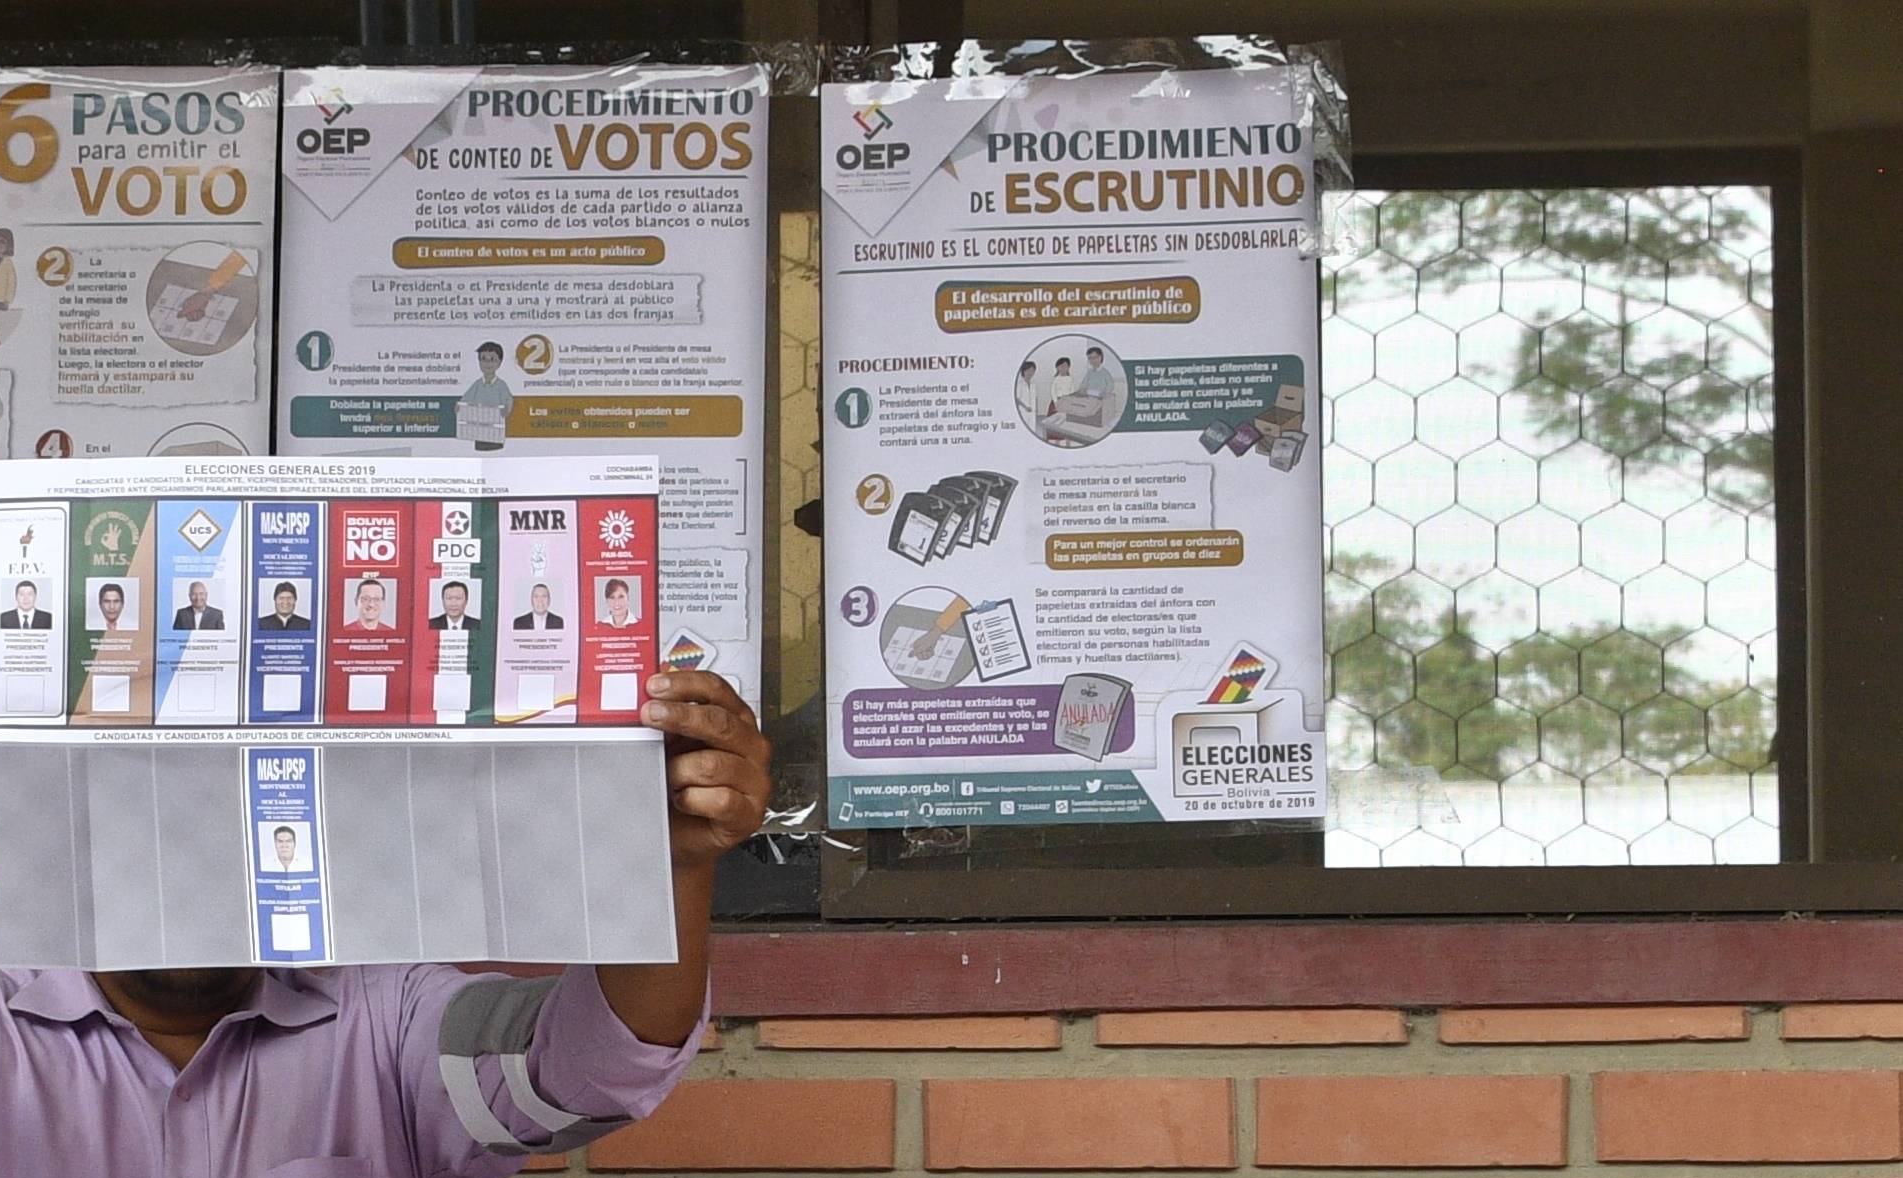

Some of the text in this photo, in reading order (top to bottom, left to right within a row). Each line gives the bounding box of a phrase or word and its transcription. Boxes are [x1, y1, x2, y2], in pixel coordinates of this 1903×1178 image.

[71, 91, 245, 136] PASOS
[468, 88, 754, 117] PROCEDIMIENTO
[78, 139, 240, 164] para emitir el
[297, 129, 370, 154] OEP
[414, 122, 752, 171] DE CONTEO DE VOTOS
[986, 123, 1302, 163] PROCEDIMIENTO
[837, 143, 910, 170] OEP
[71, 166, 248, 217] VOTO
[416, 187, 738, 202] Conteo de votos es la suma de los resultados
[970, 163, 1304, 215] DE ESCRUTINIO
[416, 202, 742, 215] de los votos válidos de cada partido o alianza
[854, 243, 934, 261] ESCRUTINIO
[942, 241, 955, 259] ES
[964, 240, 979, 258] EL
[988, 238, 1044, 257] CONTEO
[1052, 237, 1069, 255] DE
[1078, 235, 1157, 253] PAPELETAS
[1165, 232, 1187, 251] SIN
[44, 251, 66, 281] 2
[971, 288, 1052, 304] desarrollo
[1057, 287, 1079, 302] del
[1085, 286, 1159, 301] escrutinio
[1165, 284, 1182, 300] de
[944, 305, 1014, 321] papeletas
[1020, 304, 1036, 320] es
[1041, 303, 1058, 319] de
[1132, 301, 1191, 317] público
[307, 337, 320, 368] 1
[523, 338, 546, 370] 2
[838, 355, 975, 374] PROCEDIMIENTO:
[845, 392, 859, 426] 1
[185, 465, 375, 476] ELECCIONES GENERALES 2019
[864, 478, 887, 511] 2
[189, 526, 212, 535] UCS
[260, 512, 310, 534] MAS-IPSP
[348, 518, 395, 526] BOLIVIA
[509, 510, 567, 531] MNR
[347, 527, 396, 540] DICE
[93, 554, 131, 566] M.T.S.
[347, 540, 396, 560] NO
[437, 544, 476, 558] PDC
[849, 590, 869, 622] 3
[94, 732, 152, 741] CANDIDATAS
[164, 732, 223, 740] CANDIDATOS
[236, 732, 287, 740] DIPUTADOS
[291, 731, 302, 740] DE
[395, 731, 452, 739] UNINOMINAL
[1182, 743, 1313, 766] ELECCIONES
[257, 758, 306, 780] MAS-IPSP
[1182, 765, 1314, 786] GENERALES
[853, 783, 950, 797] www.oep.org.bo
[1227, 786, 1270, 798] Bolivia
[1185, 797, 1314, 812] 20 de octubre de 2019
